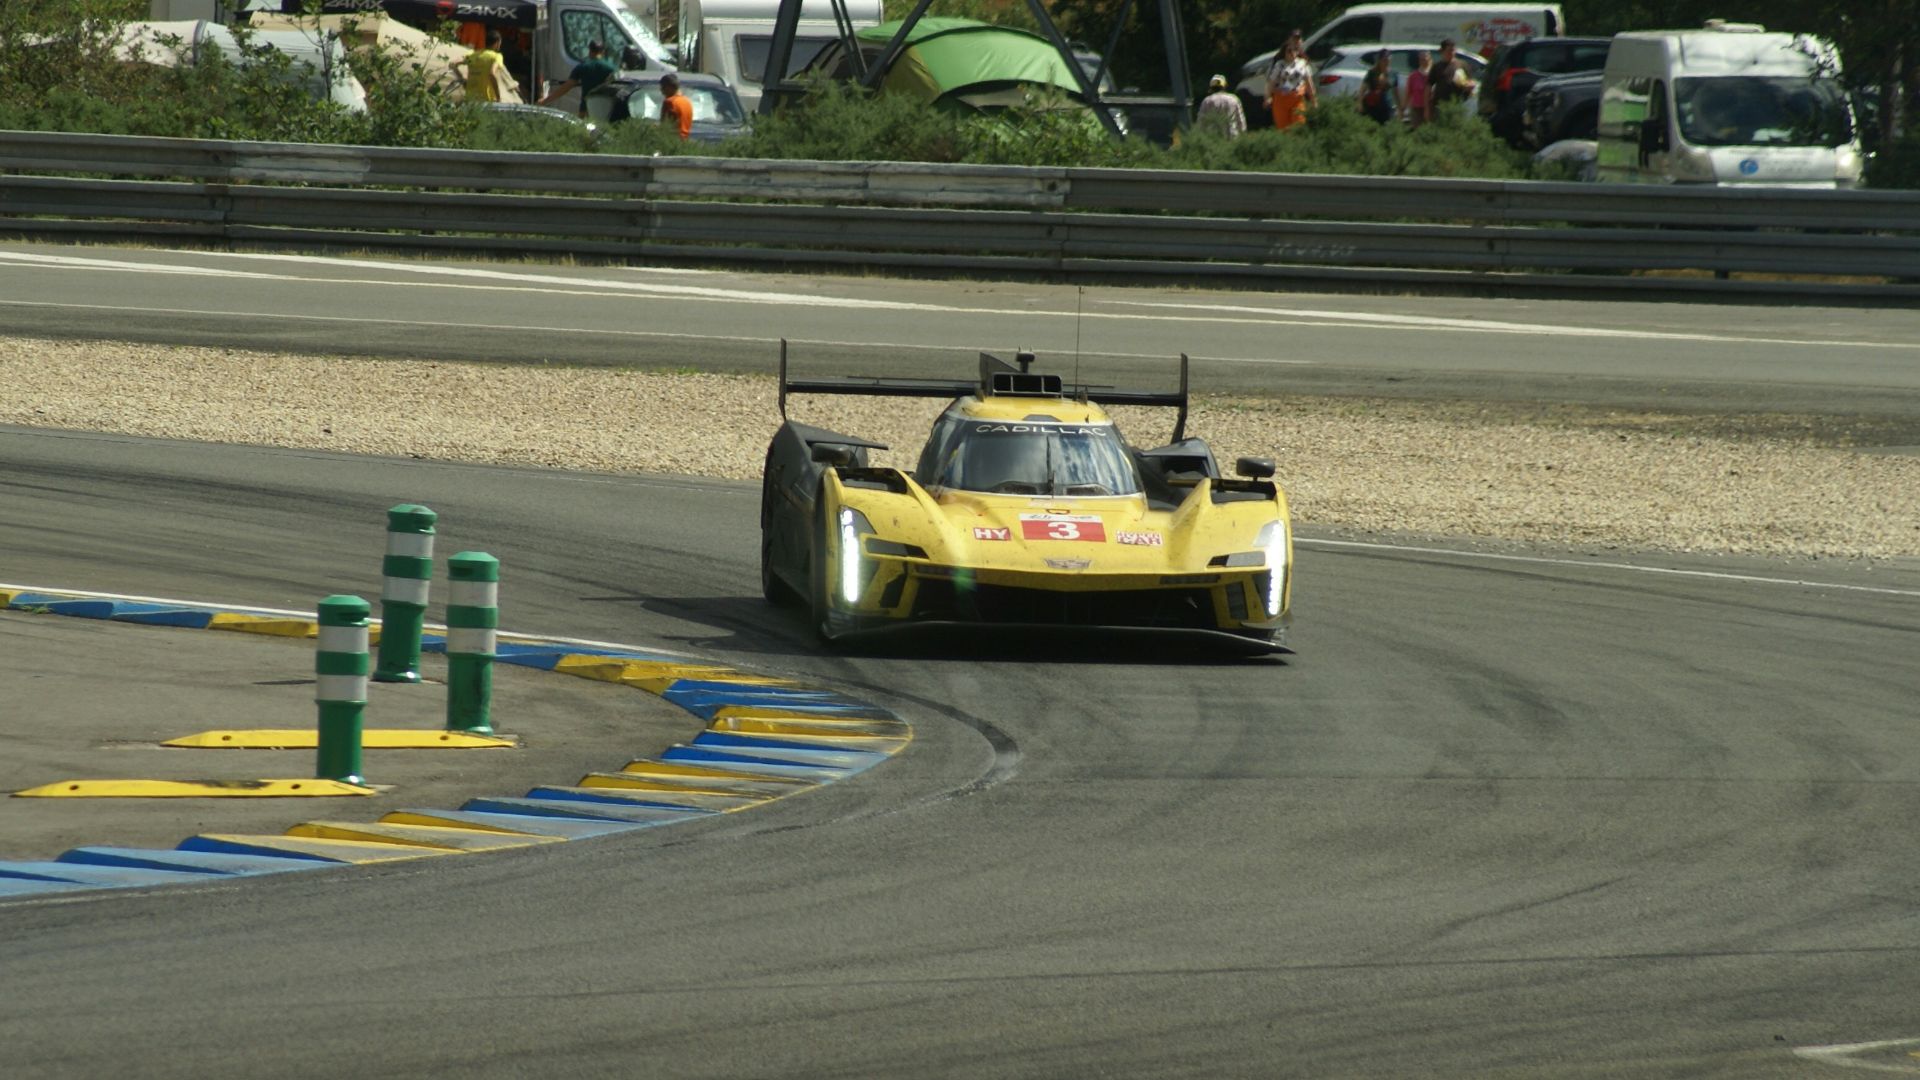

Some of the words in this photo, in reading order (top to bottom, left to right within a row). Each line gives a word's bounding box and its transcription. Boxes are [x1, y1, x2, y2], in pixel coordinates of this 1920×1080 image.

[976, 424, 1107, 437] CADILLAC
[975, 528, 1008, 540] HY
[1047, 521, 1081, 540] 3
